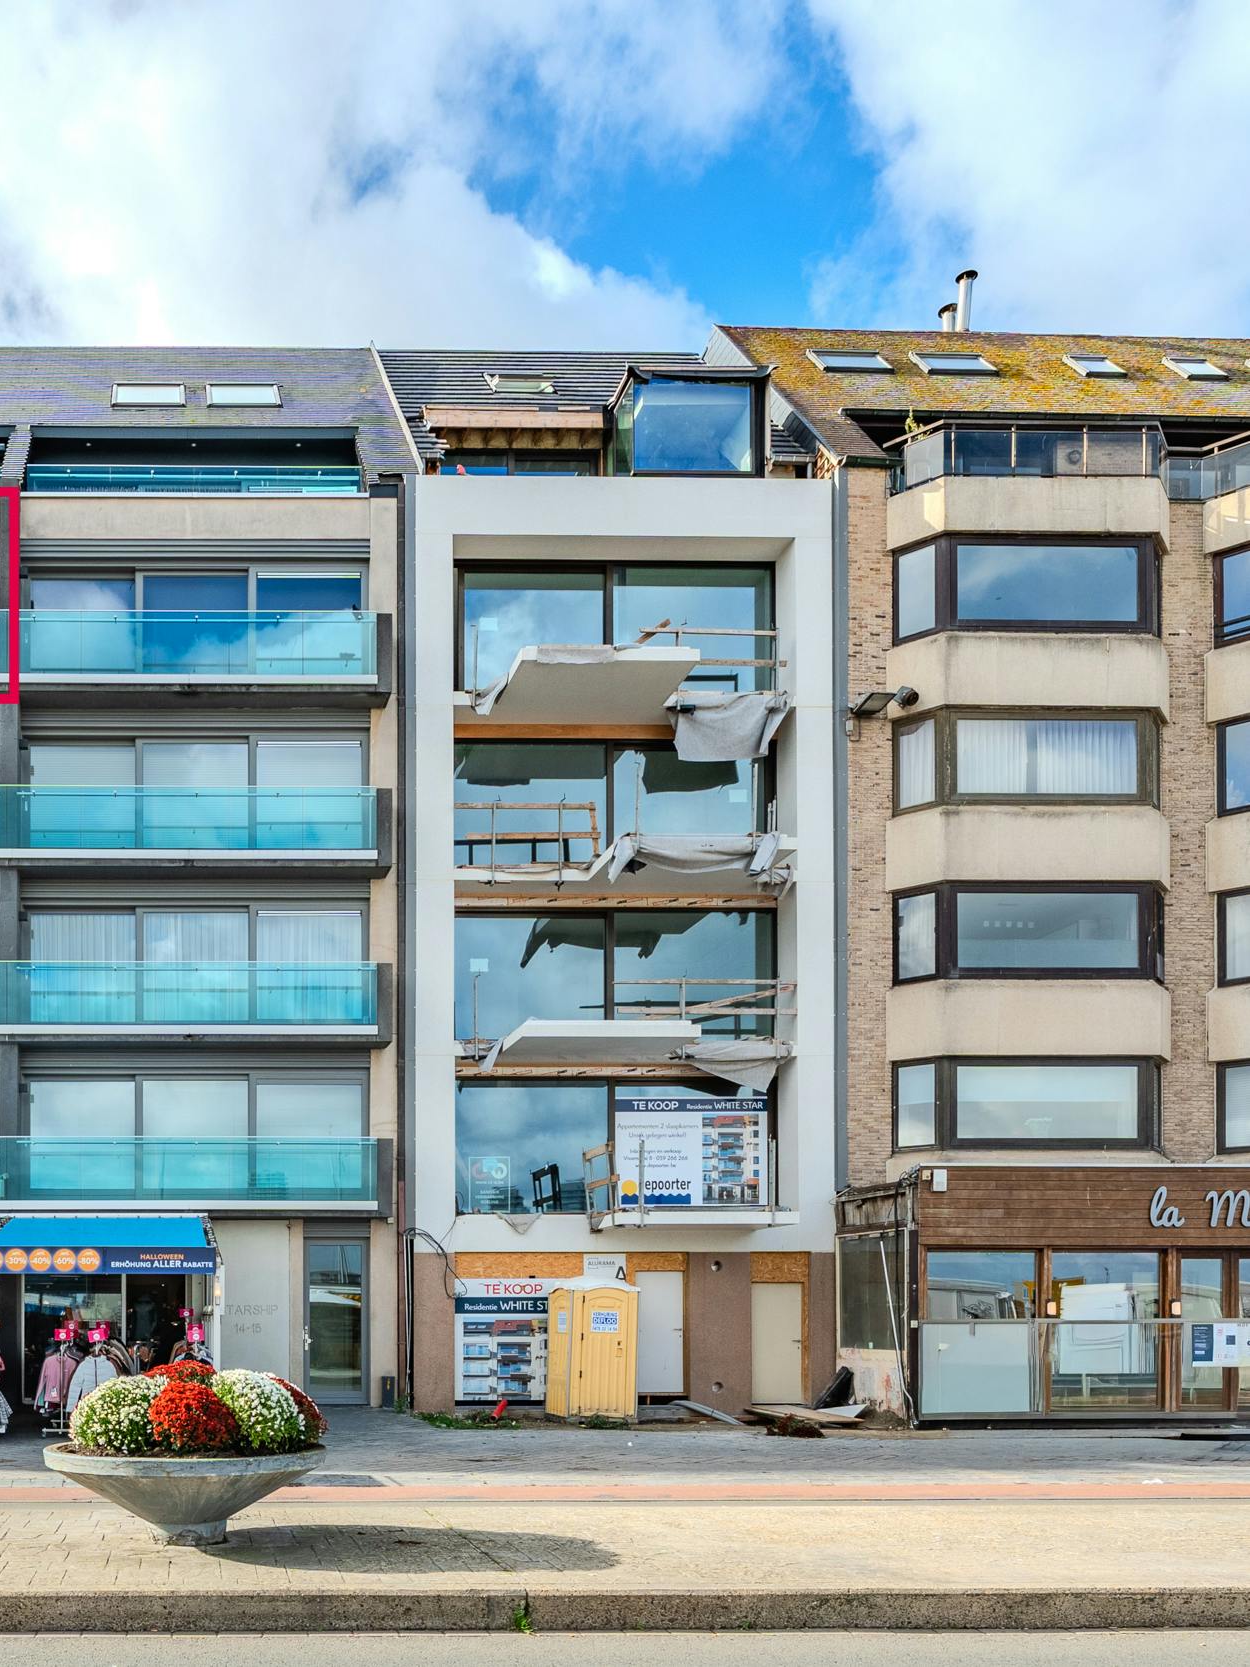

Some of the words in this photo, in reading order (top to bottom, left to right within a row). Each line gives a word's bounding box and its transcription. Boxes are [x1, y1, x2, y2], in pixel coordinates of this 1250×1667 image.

[632, 1101, 646, 1110] TE
[648, 1101, 679, 1110] KOOP
[742, 1101, 763, 1109] STAR
[644, 1178, 691, 1192] epoorter
[1150, 1186, 1185, 1228] la
[484, 1284, 500, 1294] TE
[504, 1284, 542, 1294] KOOP
[224, 1304, 278, 1315] TARSHIP
[500, 1301, 534, 1310] WHITE
[536, 1301, 548, 1310] ST
